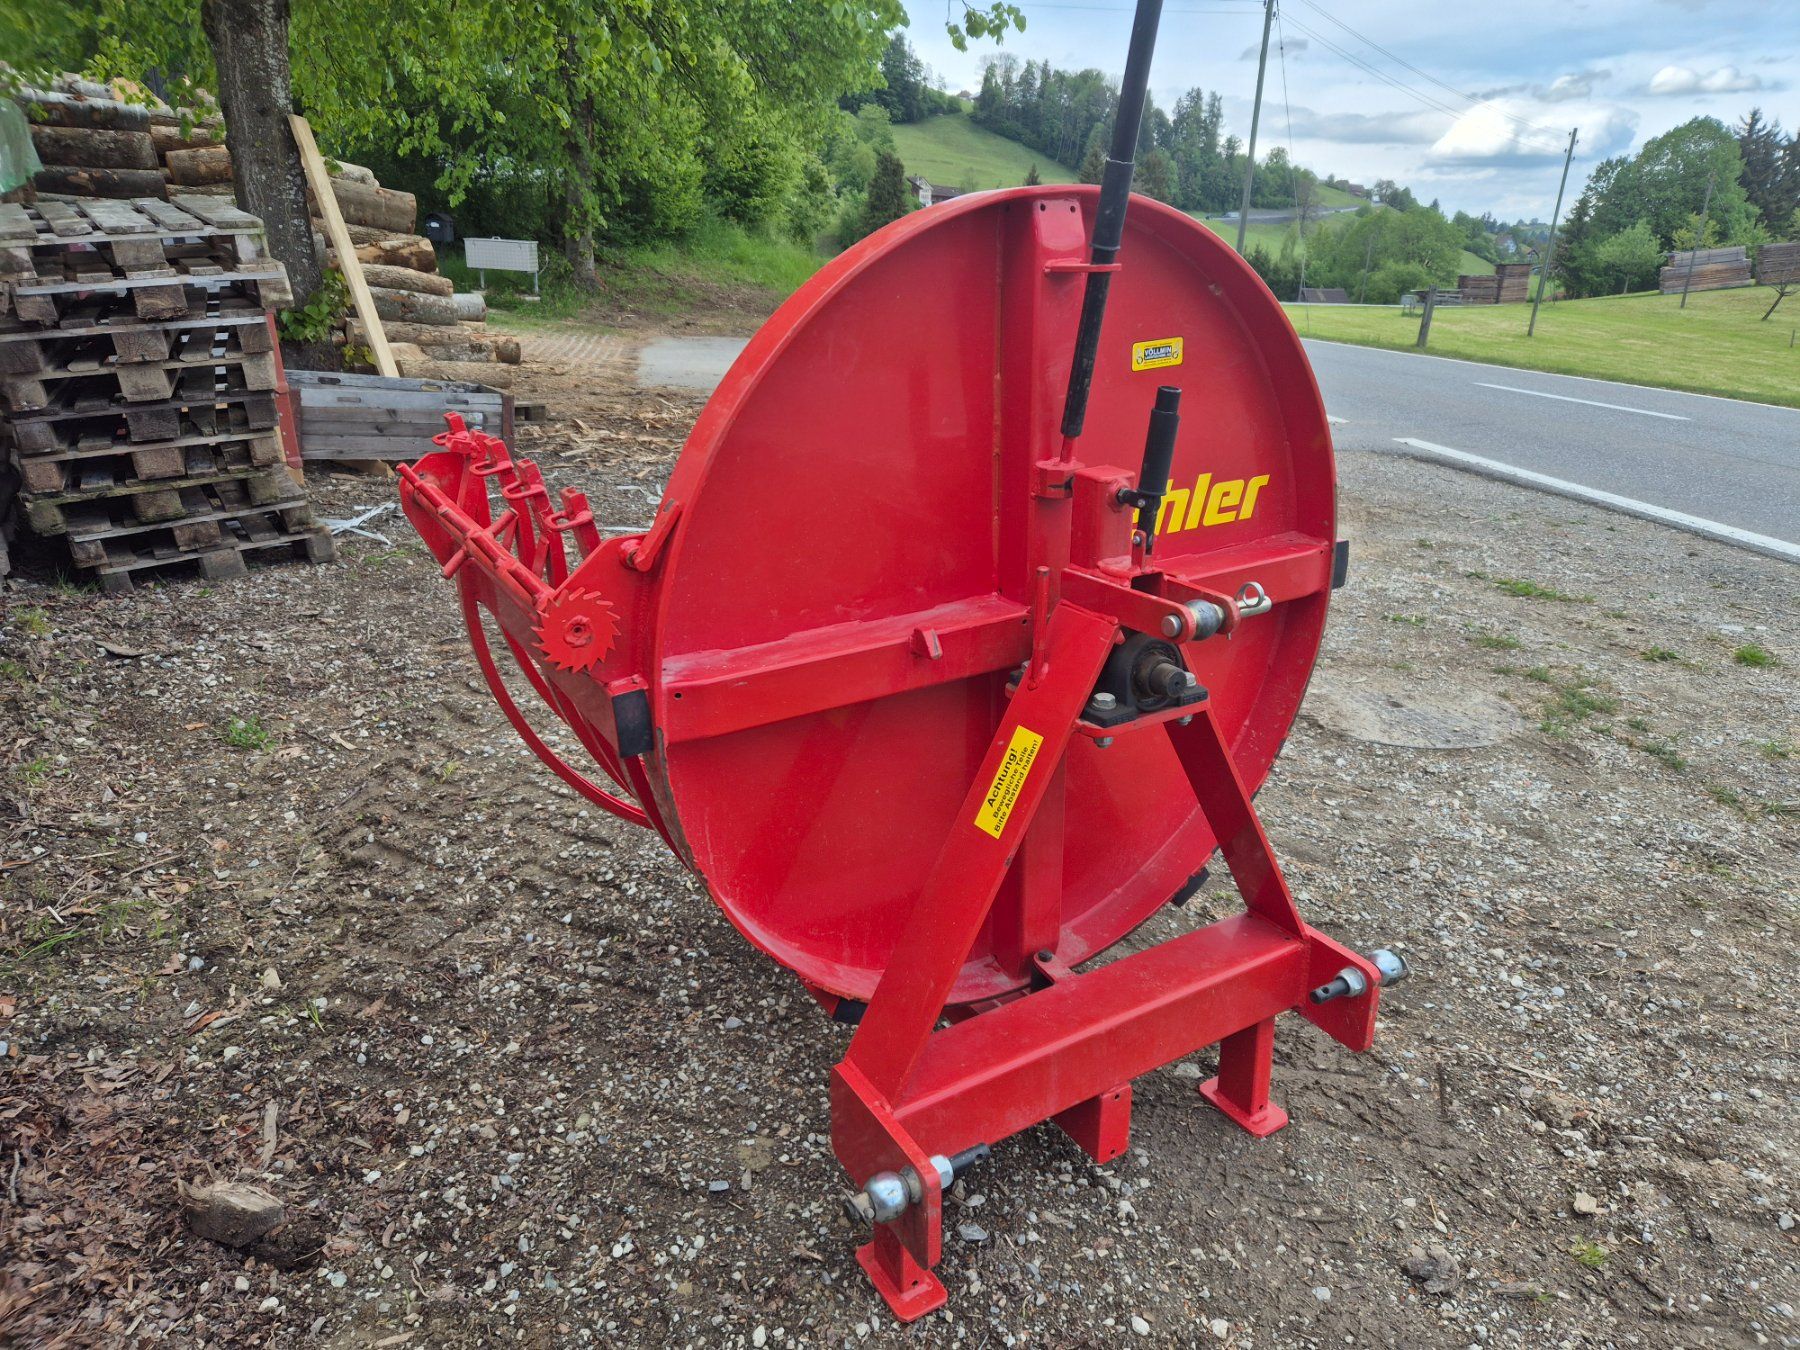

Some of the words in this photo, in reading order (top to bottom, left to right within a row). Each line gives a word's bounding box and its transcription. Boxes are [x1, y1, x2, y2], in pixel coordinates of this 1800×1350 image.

[1132, 473, 1270, 538] hler
[987, 748, 1018, 808] Achtung!
[993, 768, 1018, 818] Bewegliche
[1016, 746, 1029, 766] Teile
[994, 812, 1007, 832] Bitte
[1005, 772, 1024, 809] Abstand
[1023, 739, 1039, 771] halten!
